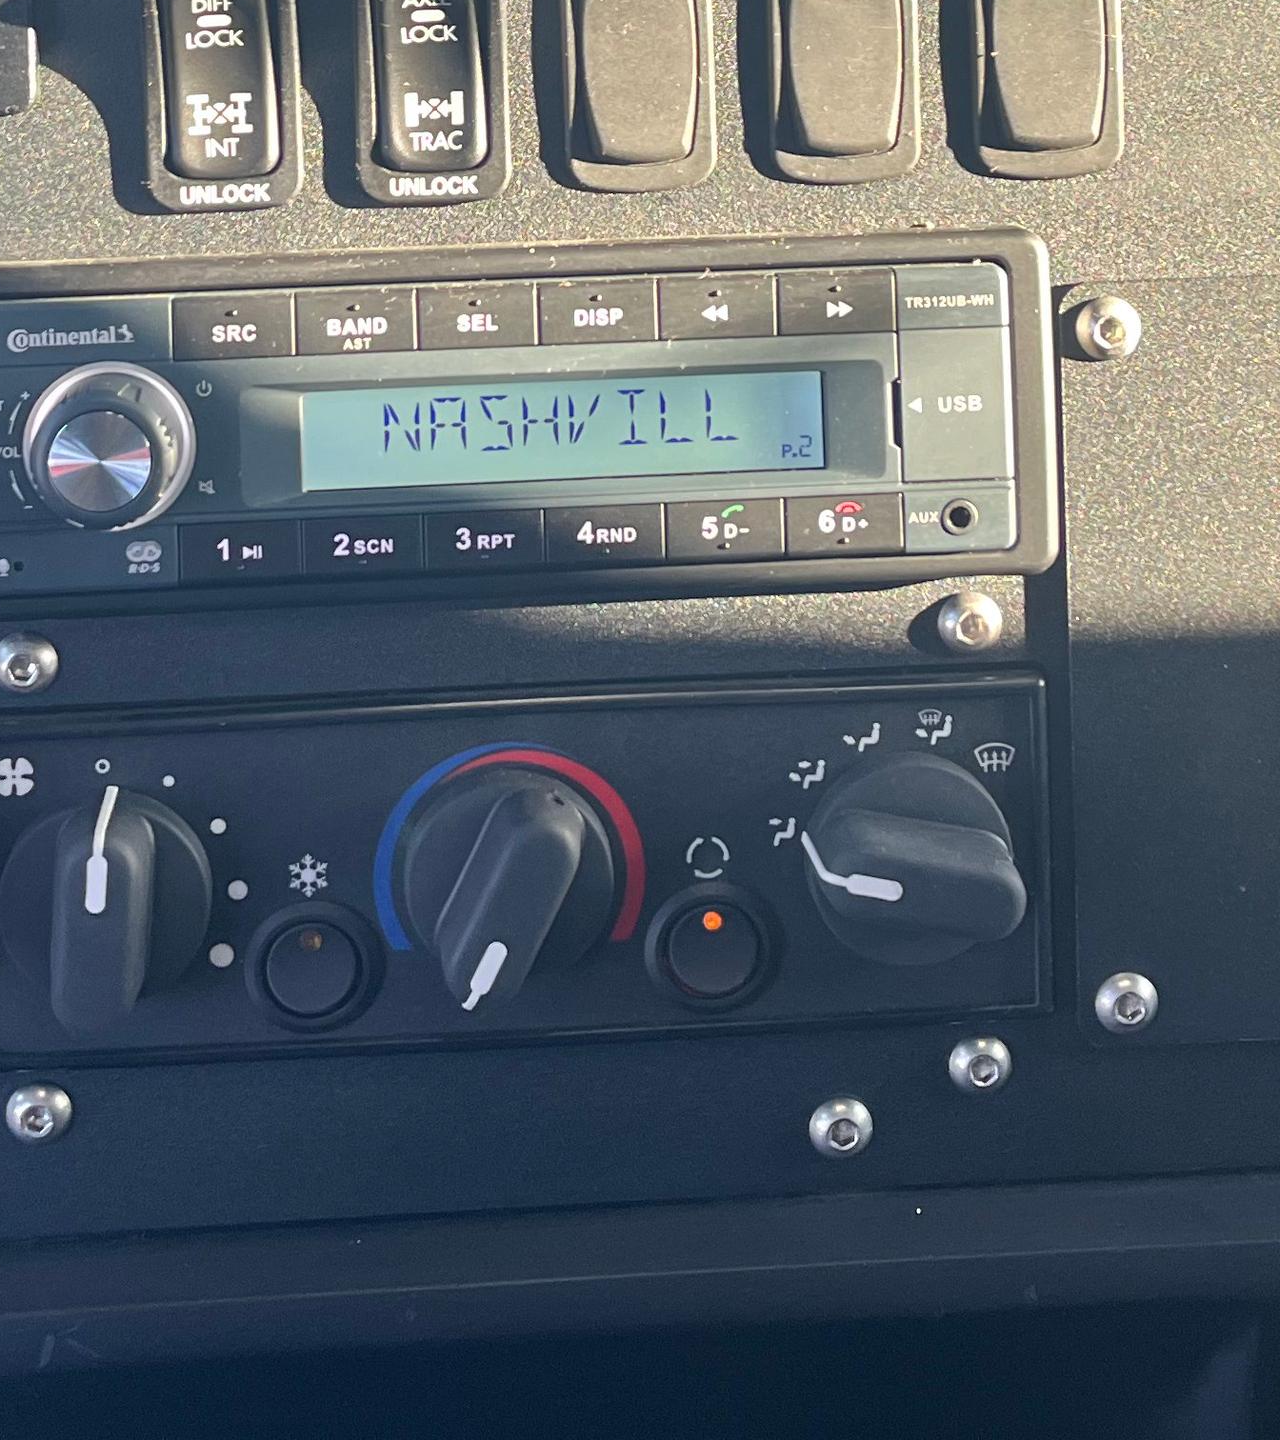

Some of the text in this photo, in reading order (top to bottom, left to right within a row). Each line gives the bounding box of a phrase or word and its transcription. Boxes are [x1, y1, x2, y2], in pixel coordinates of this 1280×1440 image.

[185, 29, 244, 50] LOCK
[400, 25, 458, 45] LOCK
[205, 137, 240, 158] INT
[409, 130, 463, 152] TRAC
[179, 182, 271, 205] UNLOCK
[389, 175, 478, 197] UNLOCK
[904, 294, 994, 310] TR312UB-WH
[326, 317, 388, 337] BAND
[456, 314, 499, 332] SEL
[573, 308, 624, 327] DISP
[7, 326, 115, 353] Continental
[211, 323, 257, 343] SRC
[343, 338, 372, 351] AST
[937, 395, 983, 413] USB
[382, 388, 739, 453] NASHVILL
[908, 511, 939, 524] AUX
[217, 538, 230, 561] 1
[476, 532, 515, 551] RPT
